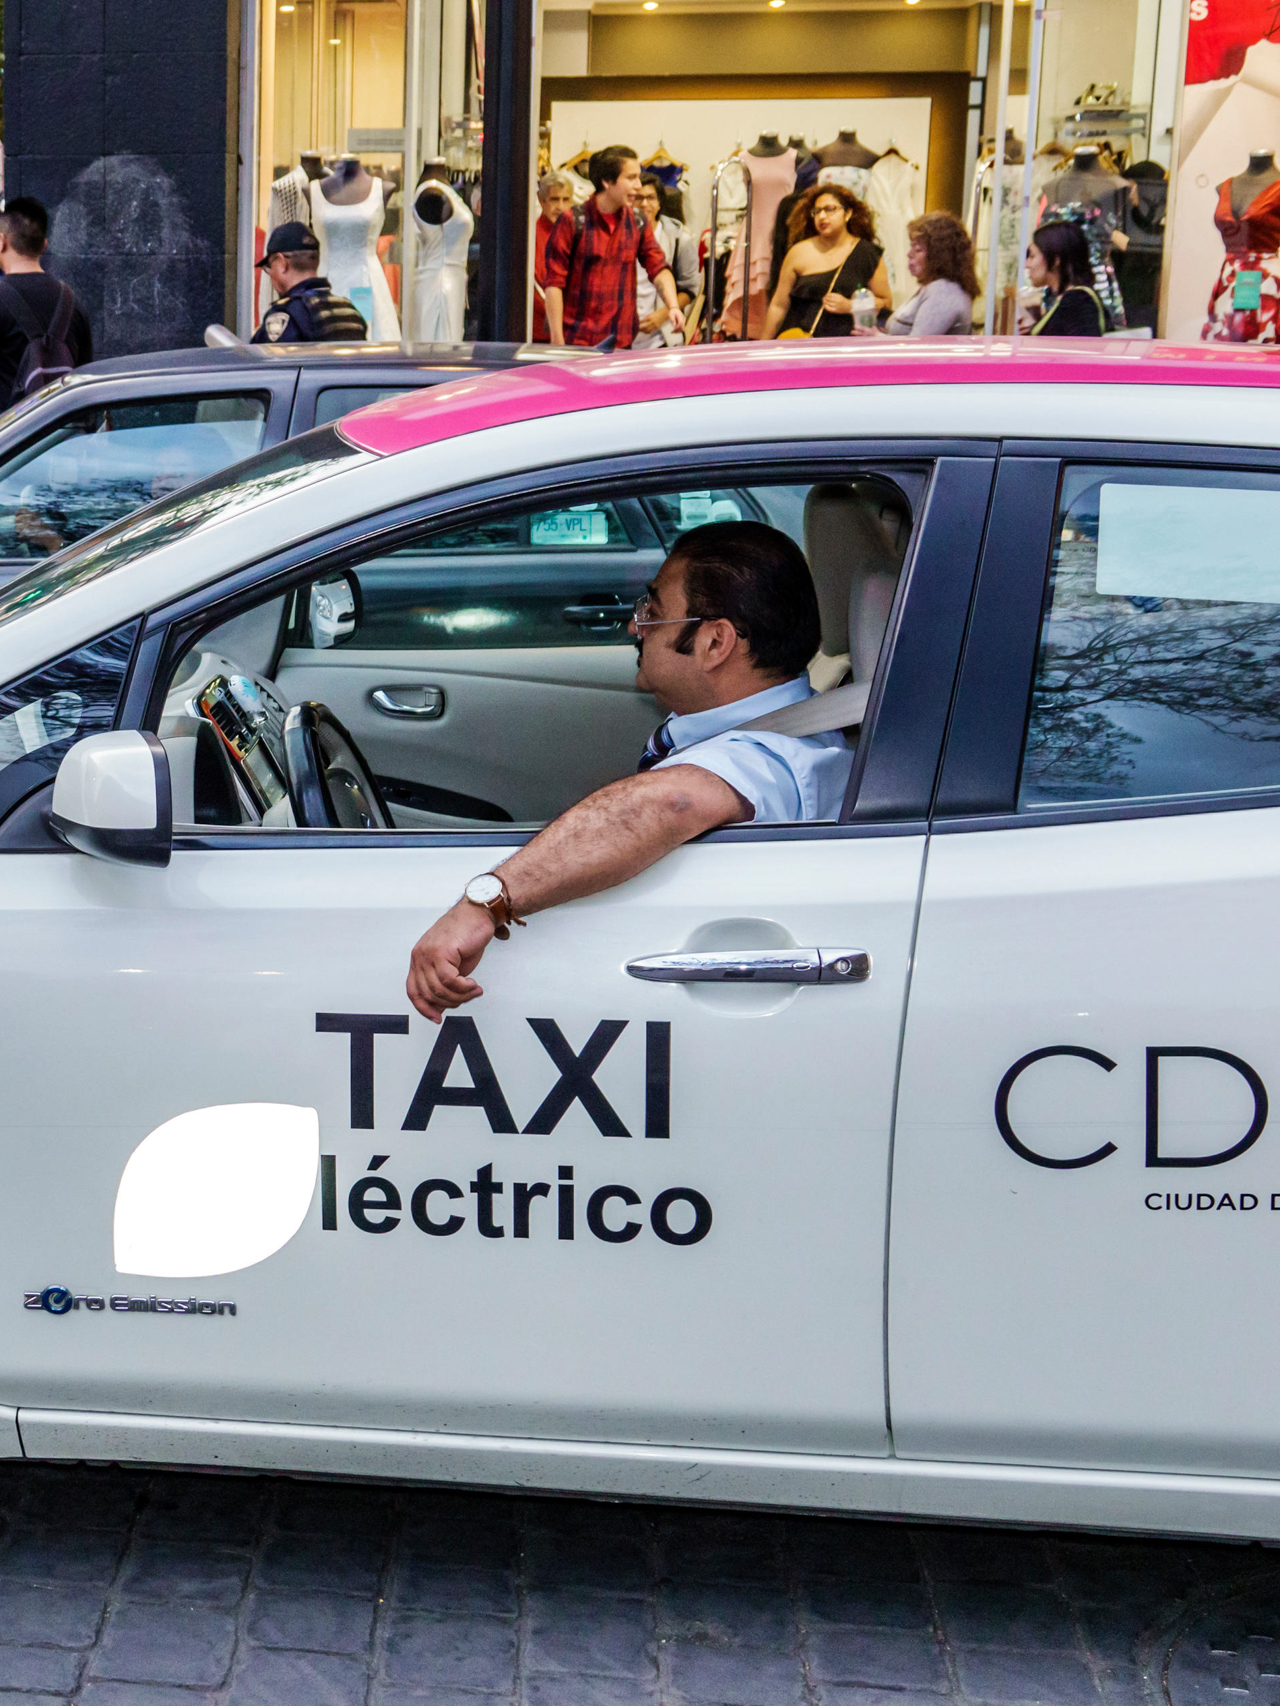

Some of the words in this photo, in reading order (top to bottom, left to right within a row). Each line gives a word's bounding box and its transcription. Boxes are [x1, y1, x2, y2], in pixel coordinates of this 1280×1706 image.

[315, 1012, 672, 1139] TAXI
[320, 1154, 713, 1246] léctrico
[1144, 1193, 1259, 1211] CIUDAD
[109, 1294, 238, 1316] Emission
